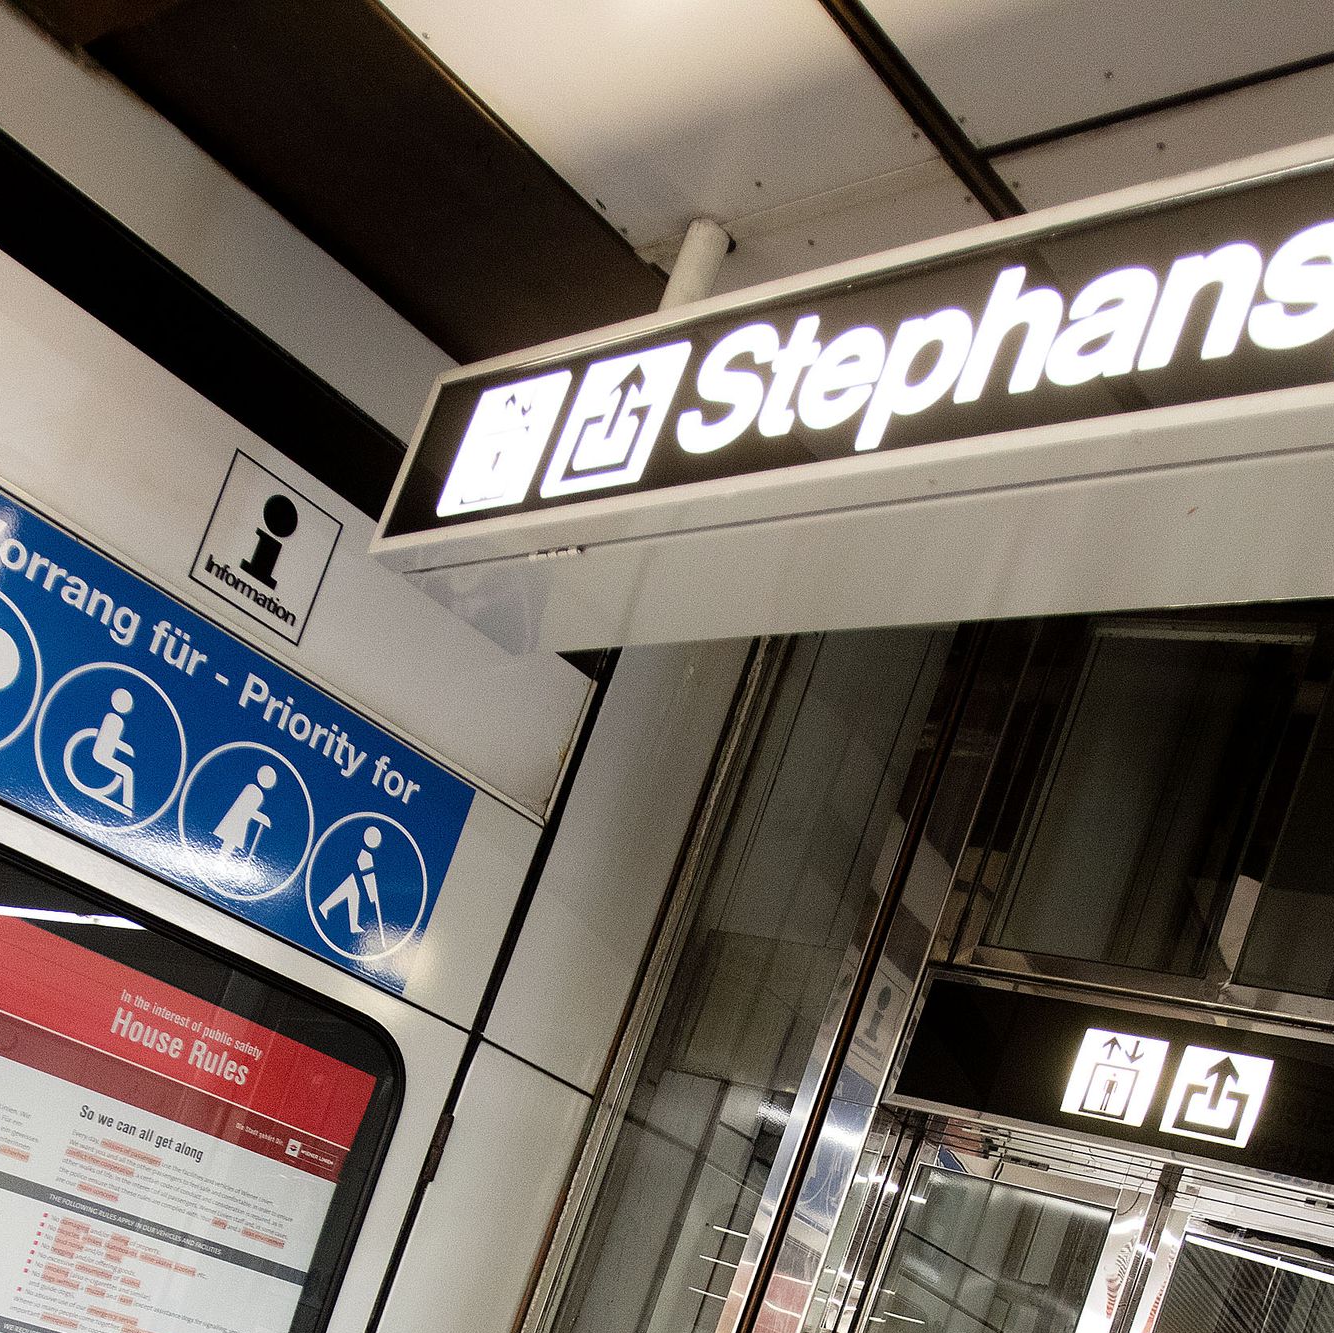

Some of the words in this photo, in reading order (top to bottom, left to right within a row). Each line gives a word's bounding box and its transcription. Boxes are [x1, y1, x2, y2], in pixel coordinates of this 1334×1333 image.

[204, 553, 297, 628] Information
[149, 620, 208, 677] für
[214, 671, 229, 687] -
[238, 672, 368, 778] Priority
[373, 756, 421, 805] for
[109, 1006, 187, 1060] House
[186, 1038, 252, 1086] Rules
[120, 989, 132, 1003] In
[132, 994, 151, 1011] the
[151, 1002, 190, 1028] interest
[190, 1018, 203, 1033] of
[201, 1024, 233, 1048] public
[232, 1037, 263, 1061] safety
[78, 1104, 96, 1121] So
[97, 1113, 114, 1128] we
[115, 1120, 136, 1136] can
[138, 1125, 154, 1142] all
[154, 1133, 174, 1152] get
[173, 1139, 205, 1163] along
